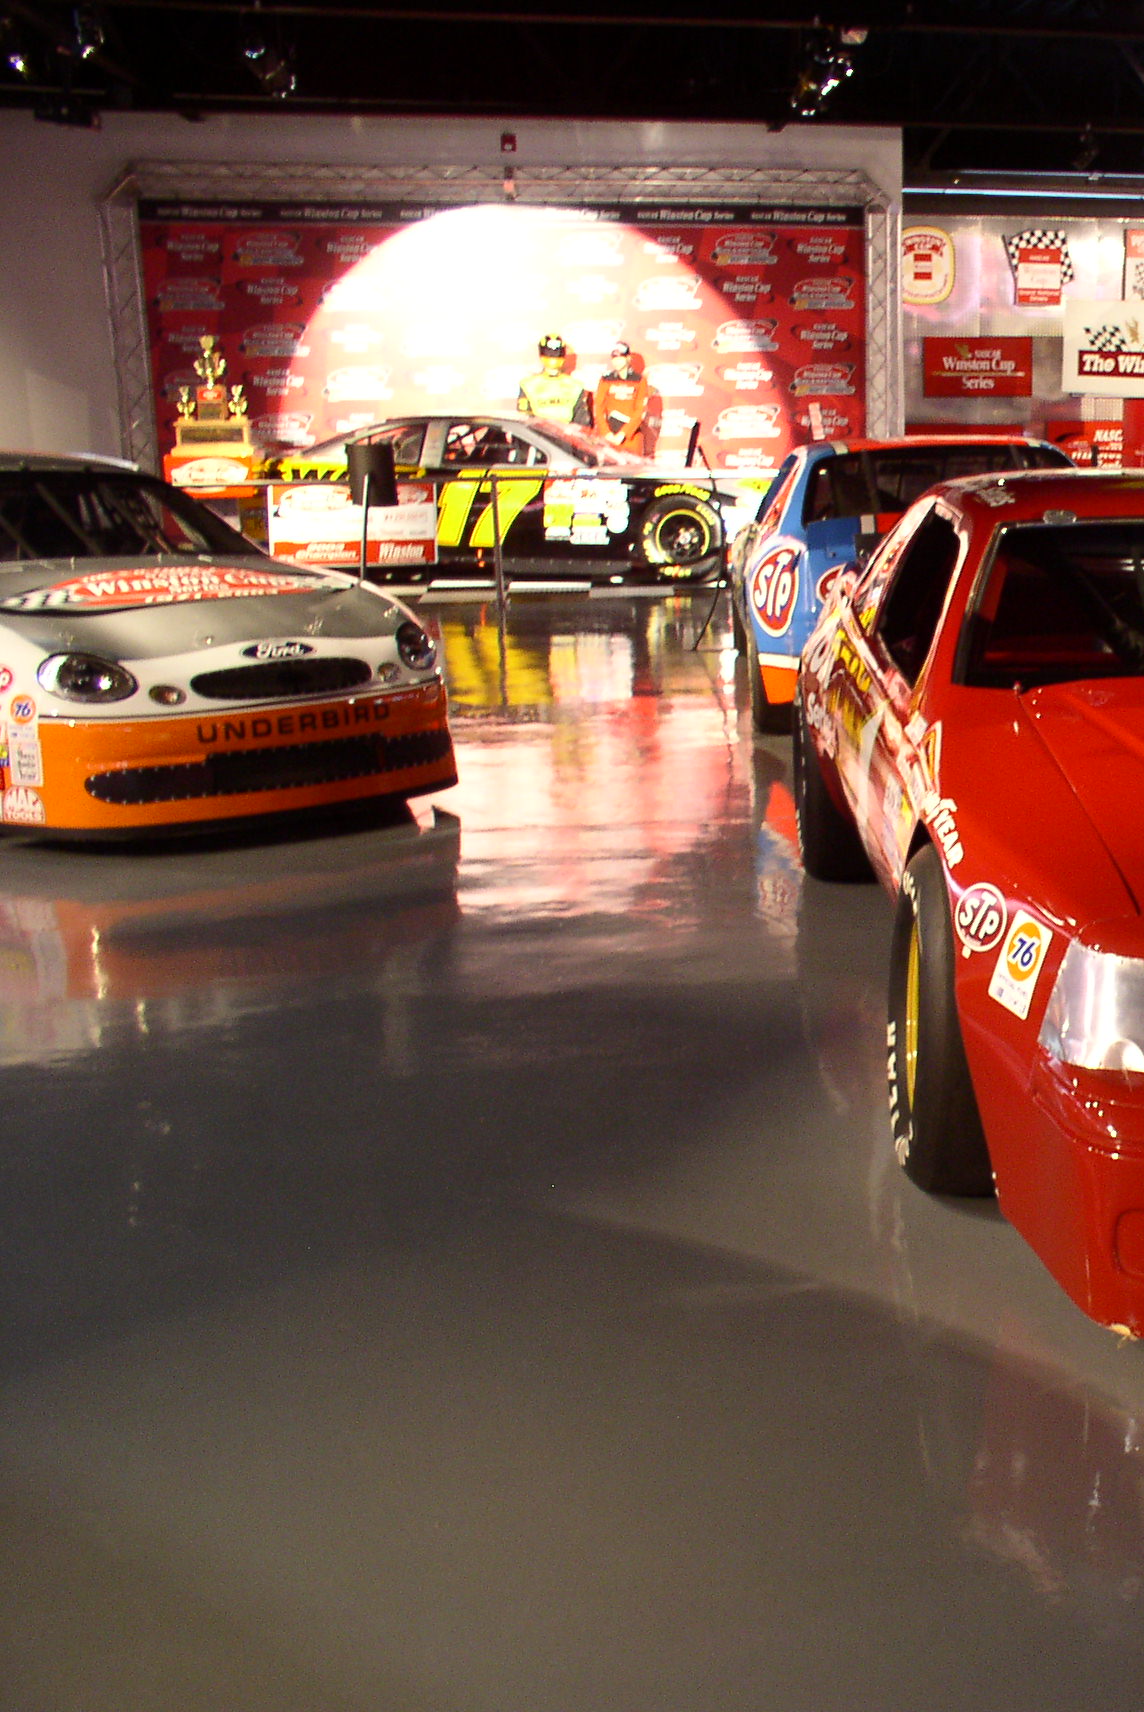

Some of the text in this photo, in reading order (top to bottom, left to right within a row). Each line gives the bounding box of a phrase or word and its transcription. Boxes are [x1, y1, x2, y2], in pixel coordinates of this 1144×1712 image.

[943, 357, 1015, 373] Winston Cup
[1082, 354, 1115, 373] The
[962, 376, 995, 390] Series
[437, 469, 548, 548] 17
[379, 542, 424, 558] Winston
[754, 550, 798, 617] STP
[256, 643, 306, 659] Ford
[16, 702, 31, 717] 76
[196, 702, 392, 743] UNDERBIRD
[957, 887, 1001, 940] STP
[1010, 935, 1038, 969] 76
